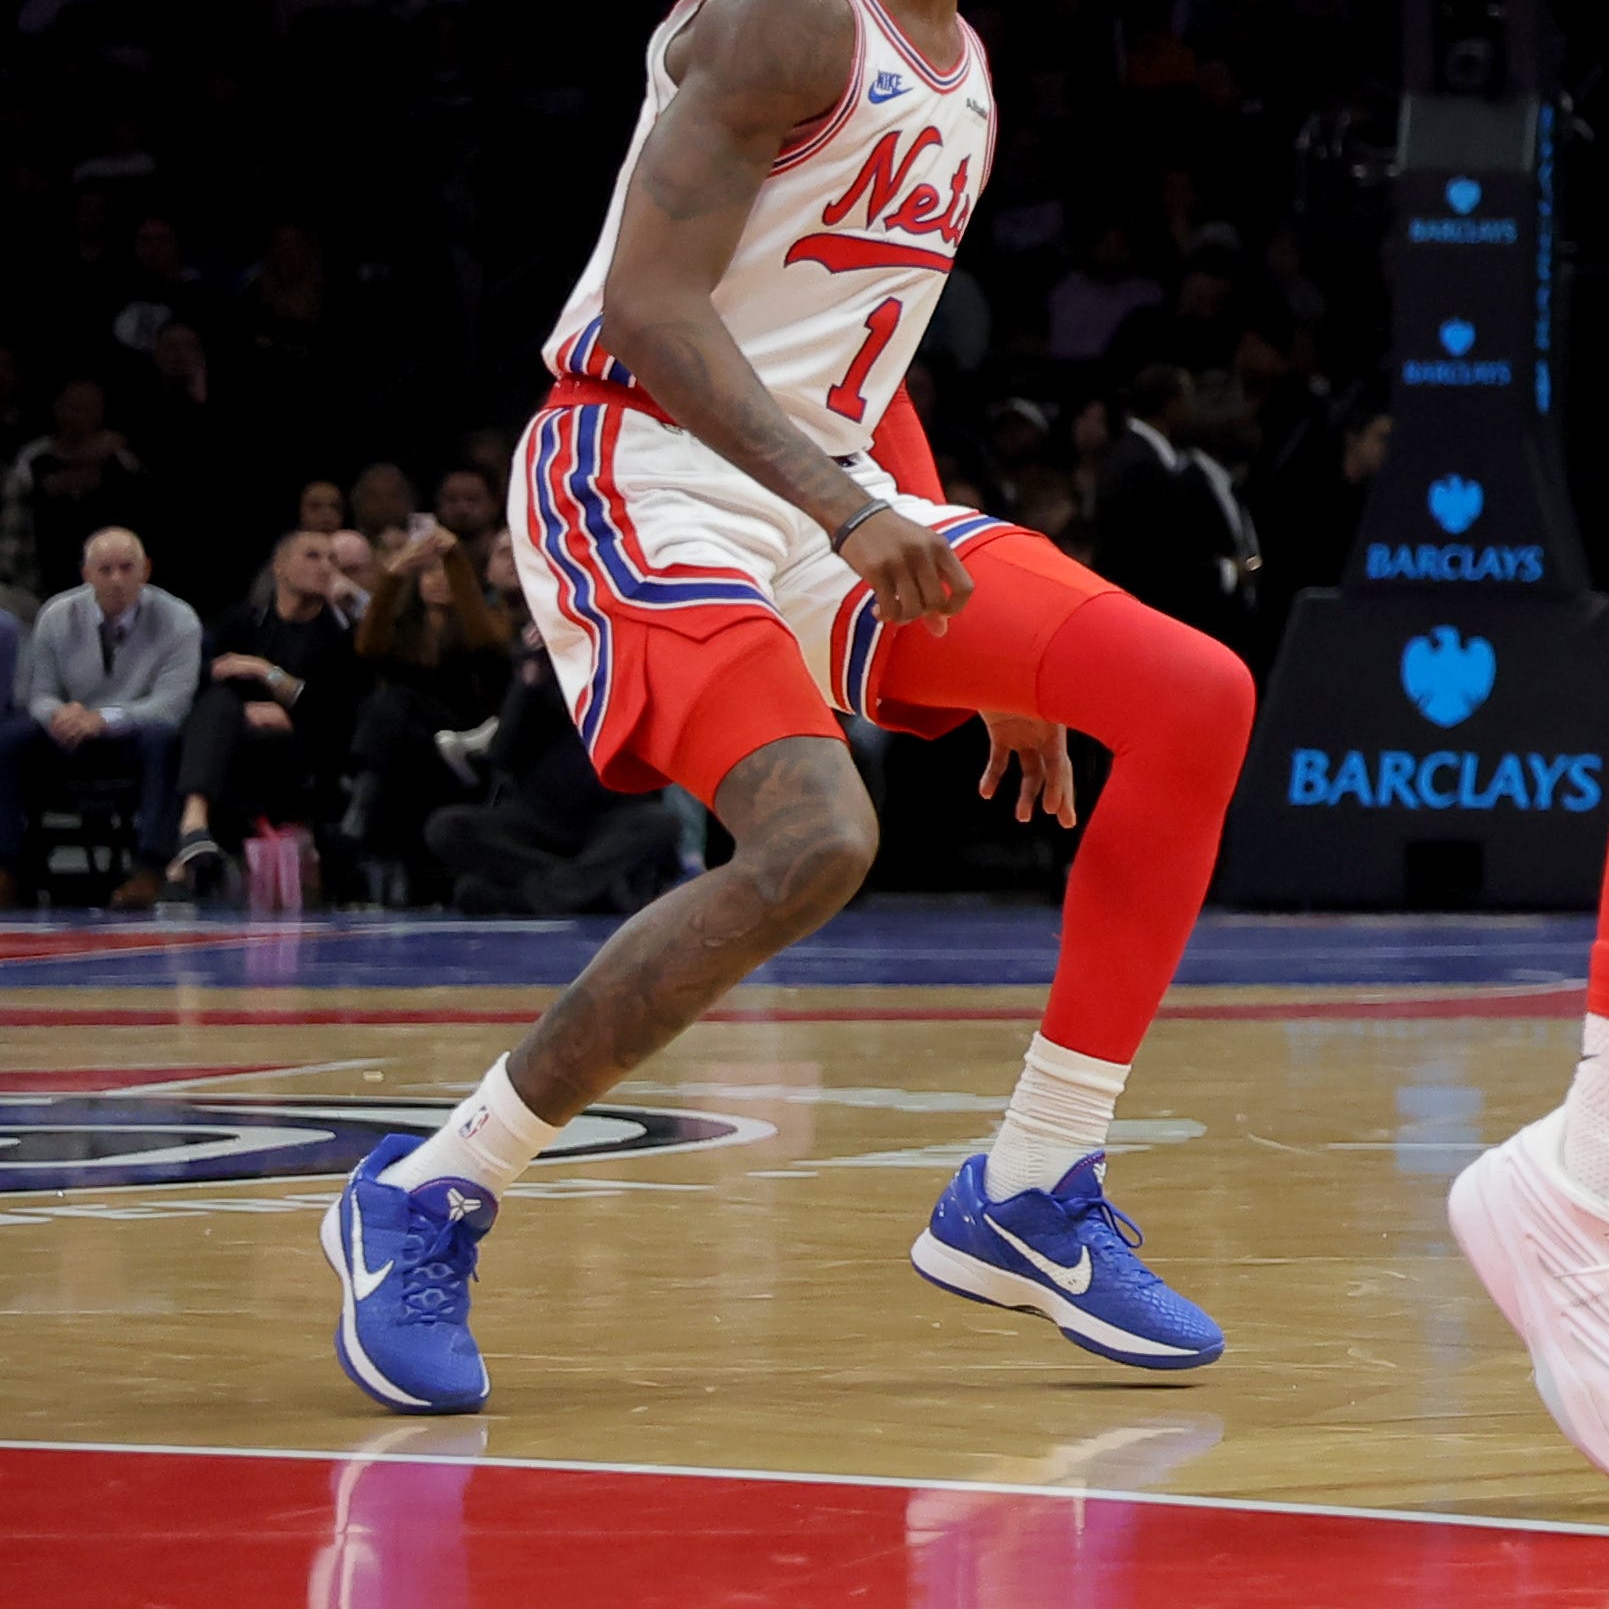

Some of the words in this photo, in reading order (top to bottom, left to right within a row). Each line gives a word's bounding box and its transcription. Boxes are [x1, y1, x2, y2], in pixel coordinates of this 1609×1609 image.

[876, 69, 904, 92] NIKE
[825, 295, 904, 424] 1
[1366, 543, 1545, 583] BARCLAYS
[1288, 747, 1603, 813] BARCLAYS
